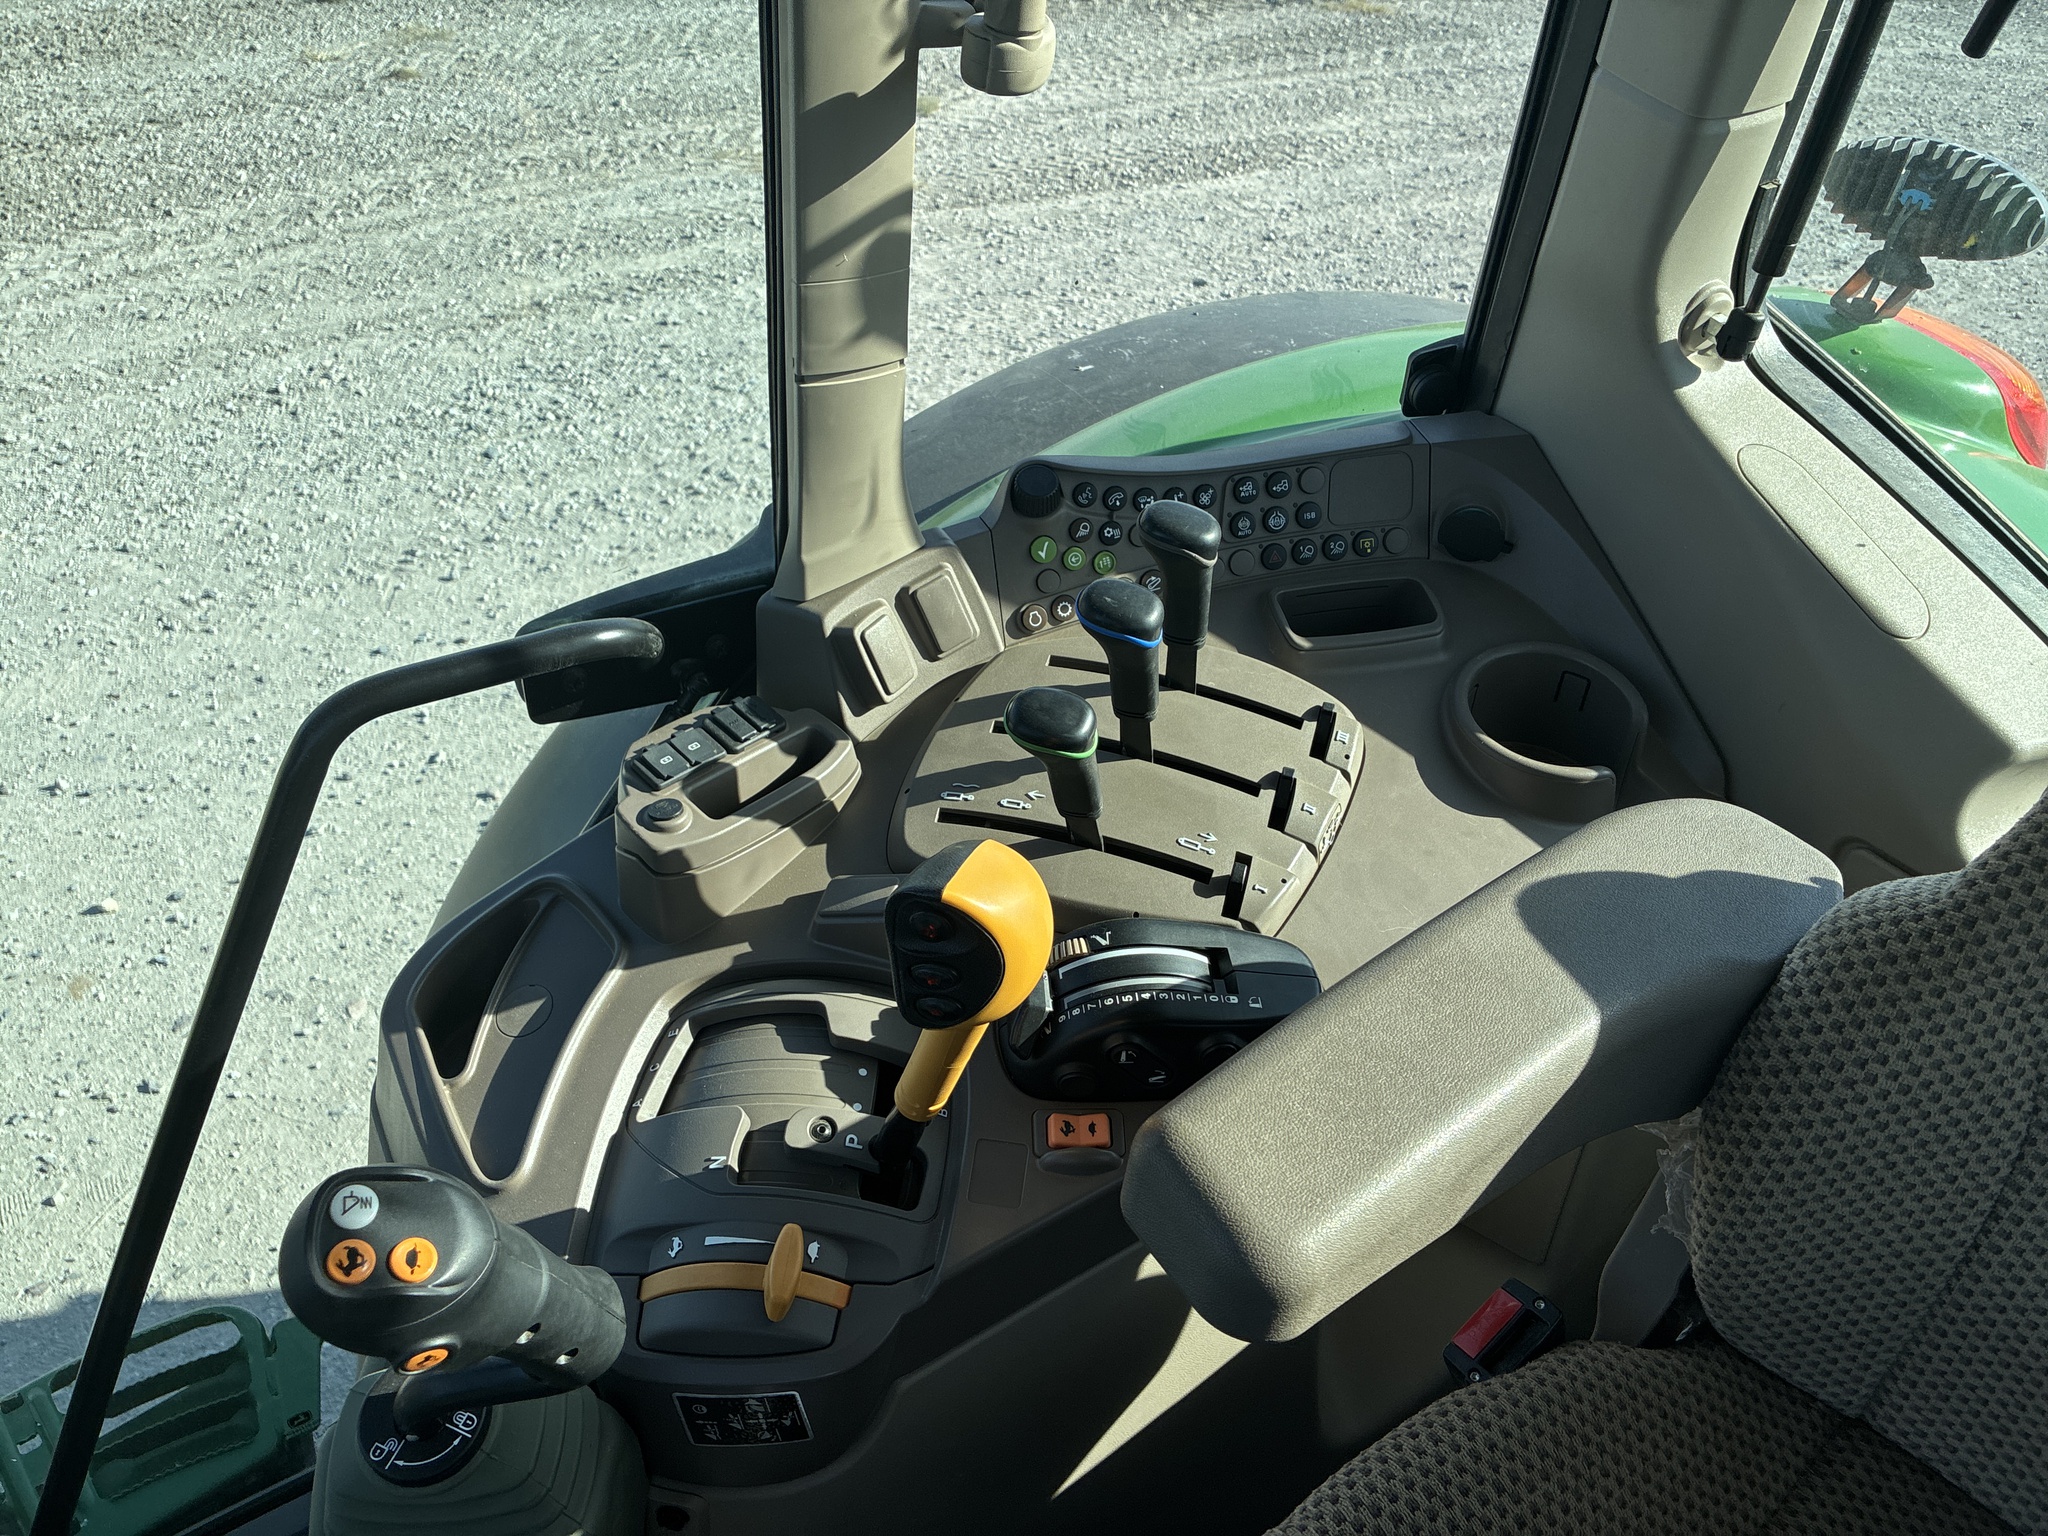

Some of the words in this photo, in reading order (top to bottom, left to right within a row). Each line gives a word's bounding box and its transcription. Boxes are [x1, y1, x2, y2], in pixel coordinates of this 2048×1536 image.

[1304, 511, 1316, 520] ISB
[1238, 529, 1252, 537] AUTO
[1058, 1014, 1067, 1023] 9
[1071, 1007, 1081, 1016] 8
[1087, 1002, 1097, 1011] 7
[1103, 997, 1114, 1006] 6
[1121, 994, 1133, 1003] 5
[1140, 992, 1152, 1000] 4
[1159, 992, 1169, 1000] 3
[1176, 993, 1187, 1001] 2
[668, 1028, 679, 1037] E
[649, 1062, 660, 1072] C
[632, 1098, 643, 1108] A
[937, 1108, 948, 1118] B
[845, 1133, 863, 1149] P
[708, 1156, 727, 1169] N
